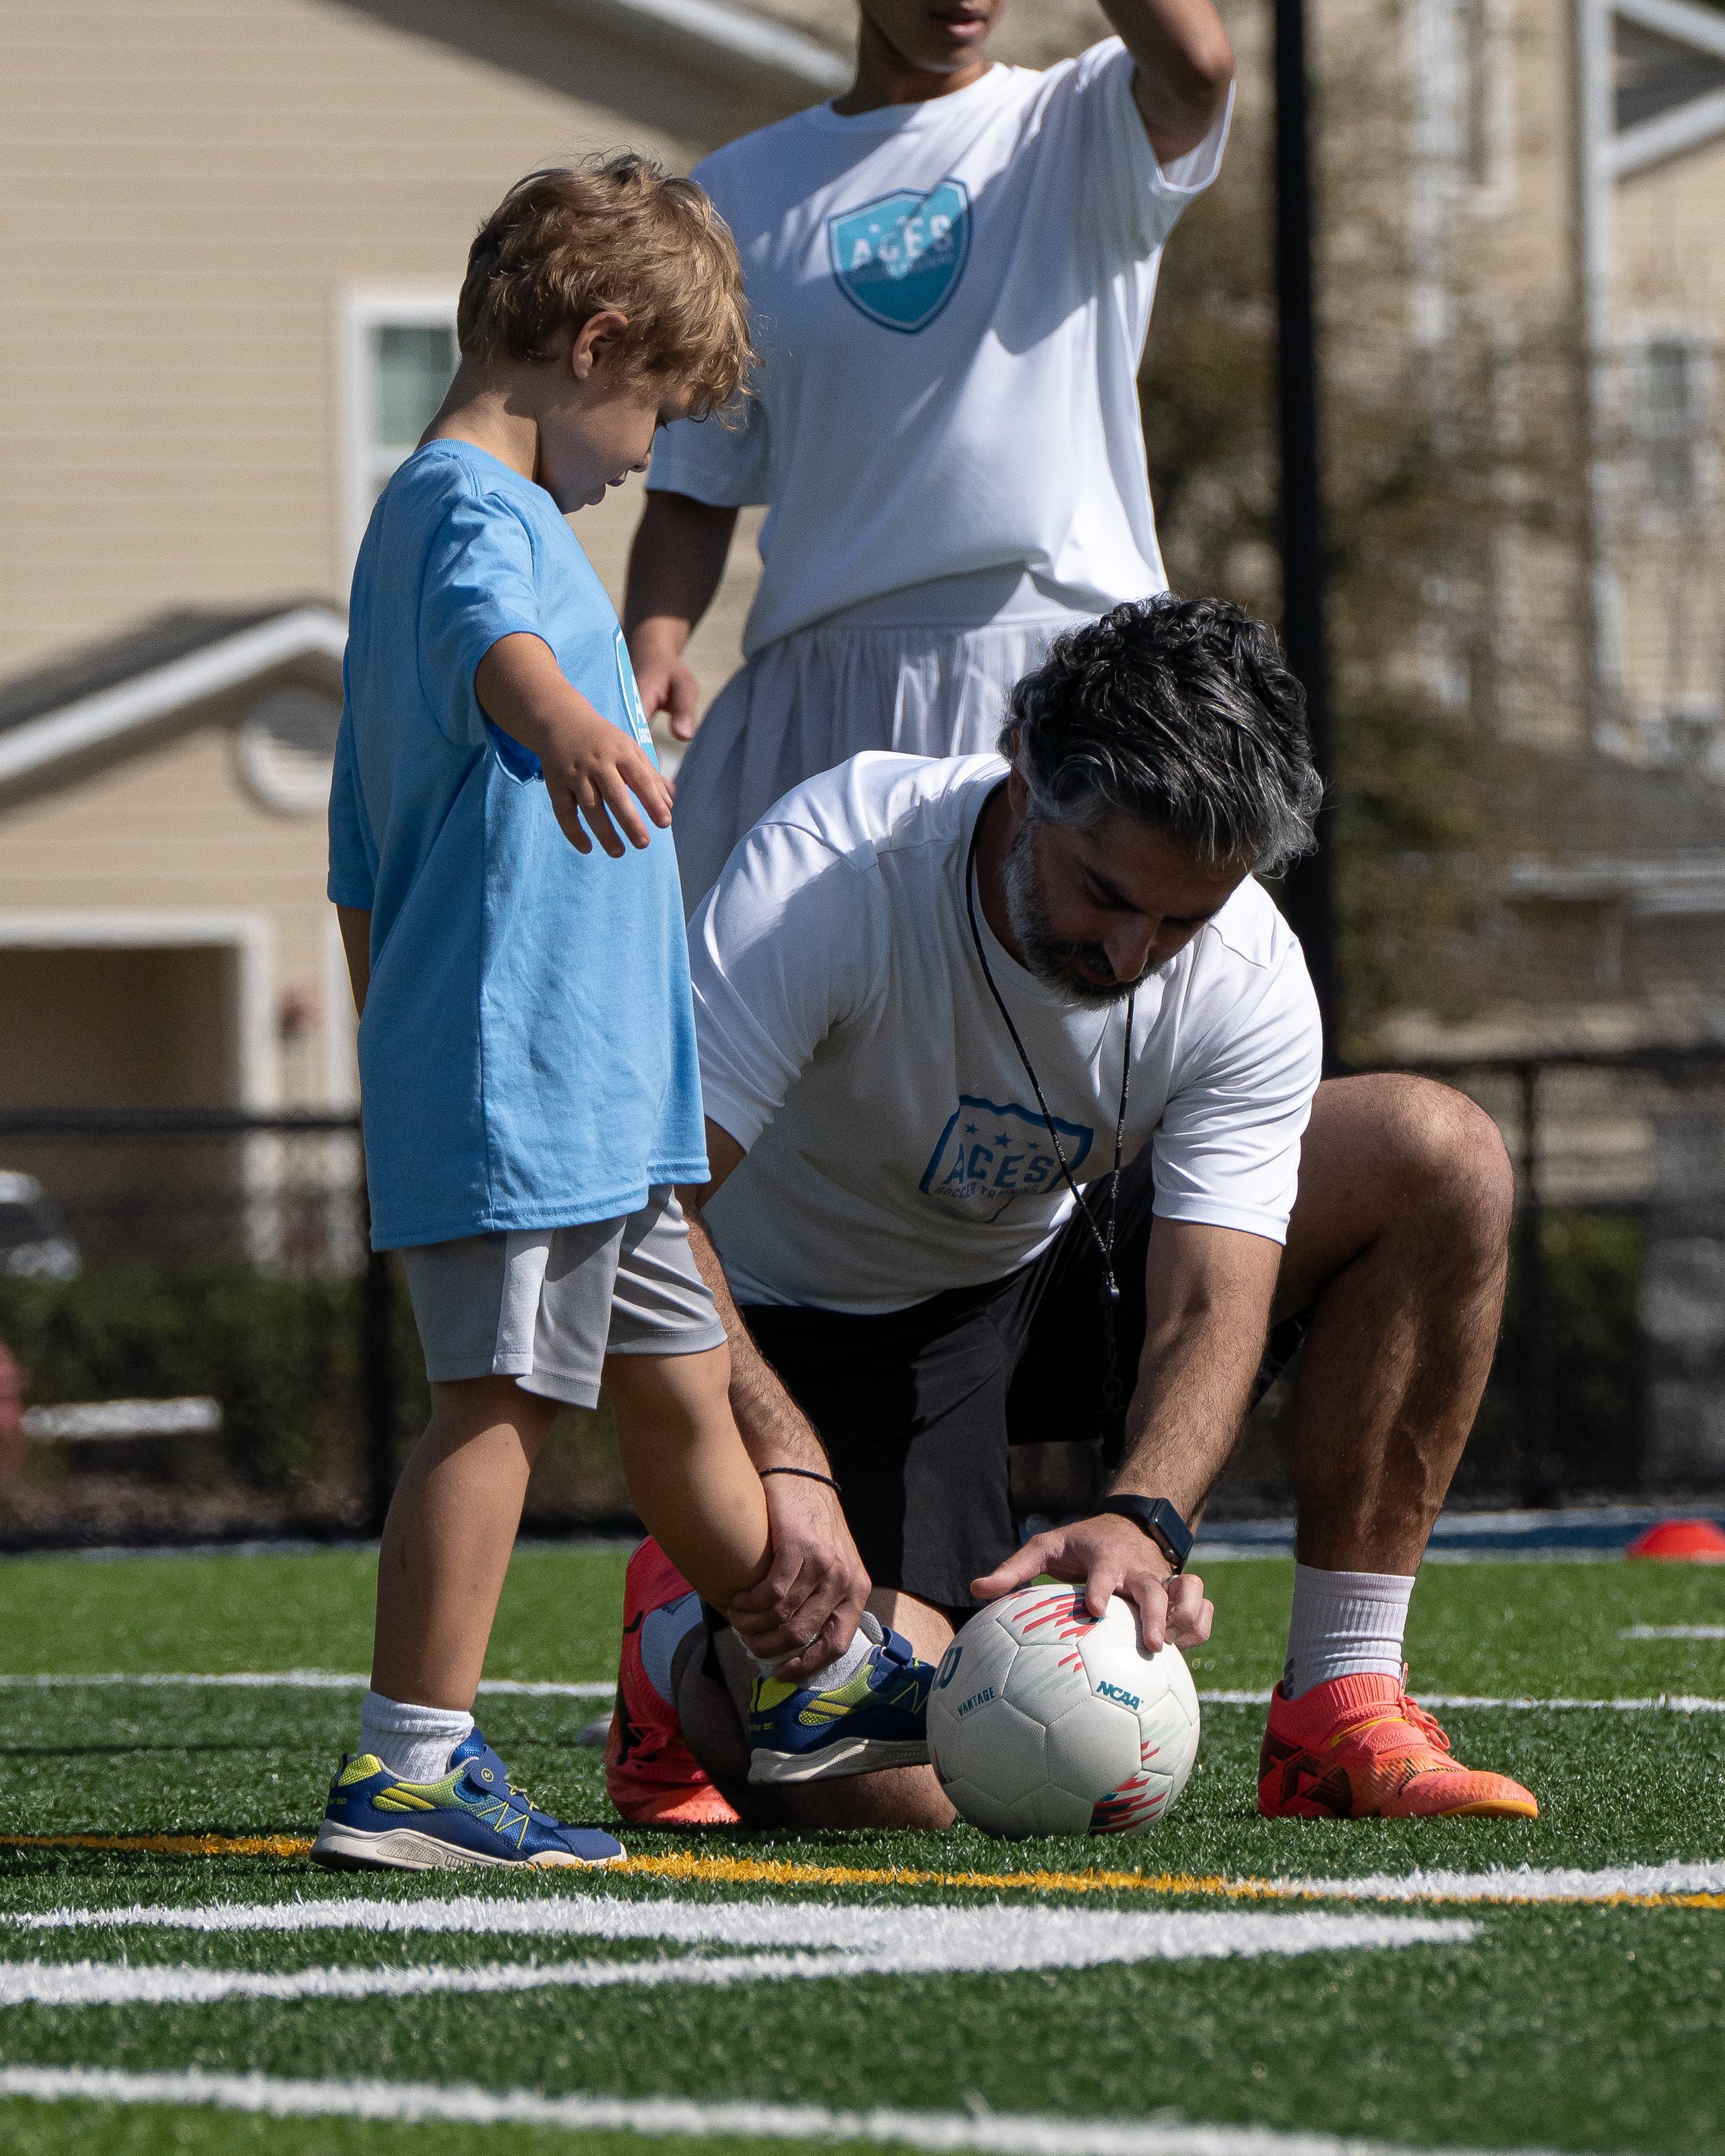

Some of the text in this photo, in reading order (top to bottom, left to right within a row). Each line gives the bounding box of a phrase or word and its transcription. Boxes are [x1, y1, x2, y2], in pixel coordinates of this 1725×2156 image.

[849, 215, 953, 271] ACES
[943, 1142, 1054, 1188] ACES
[957, 1686, 995, 1717] VANTAGE
[1096, 1681, 1140, 1710] NCAA
